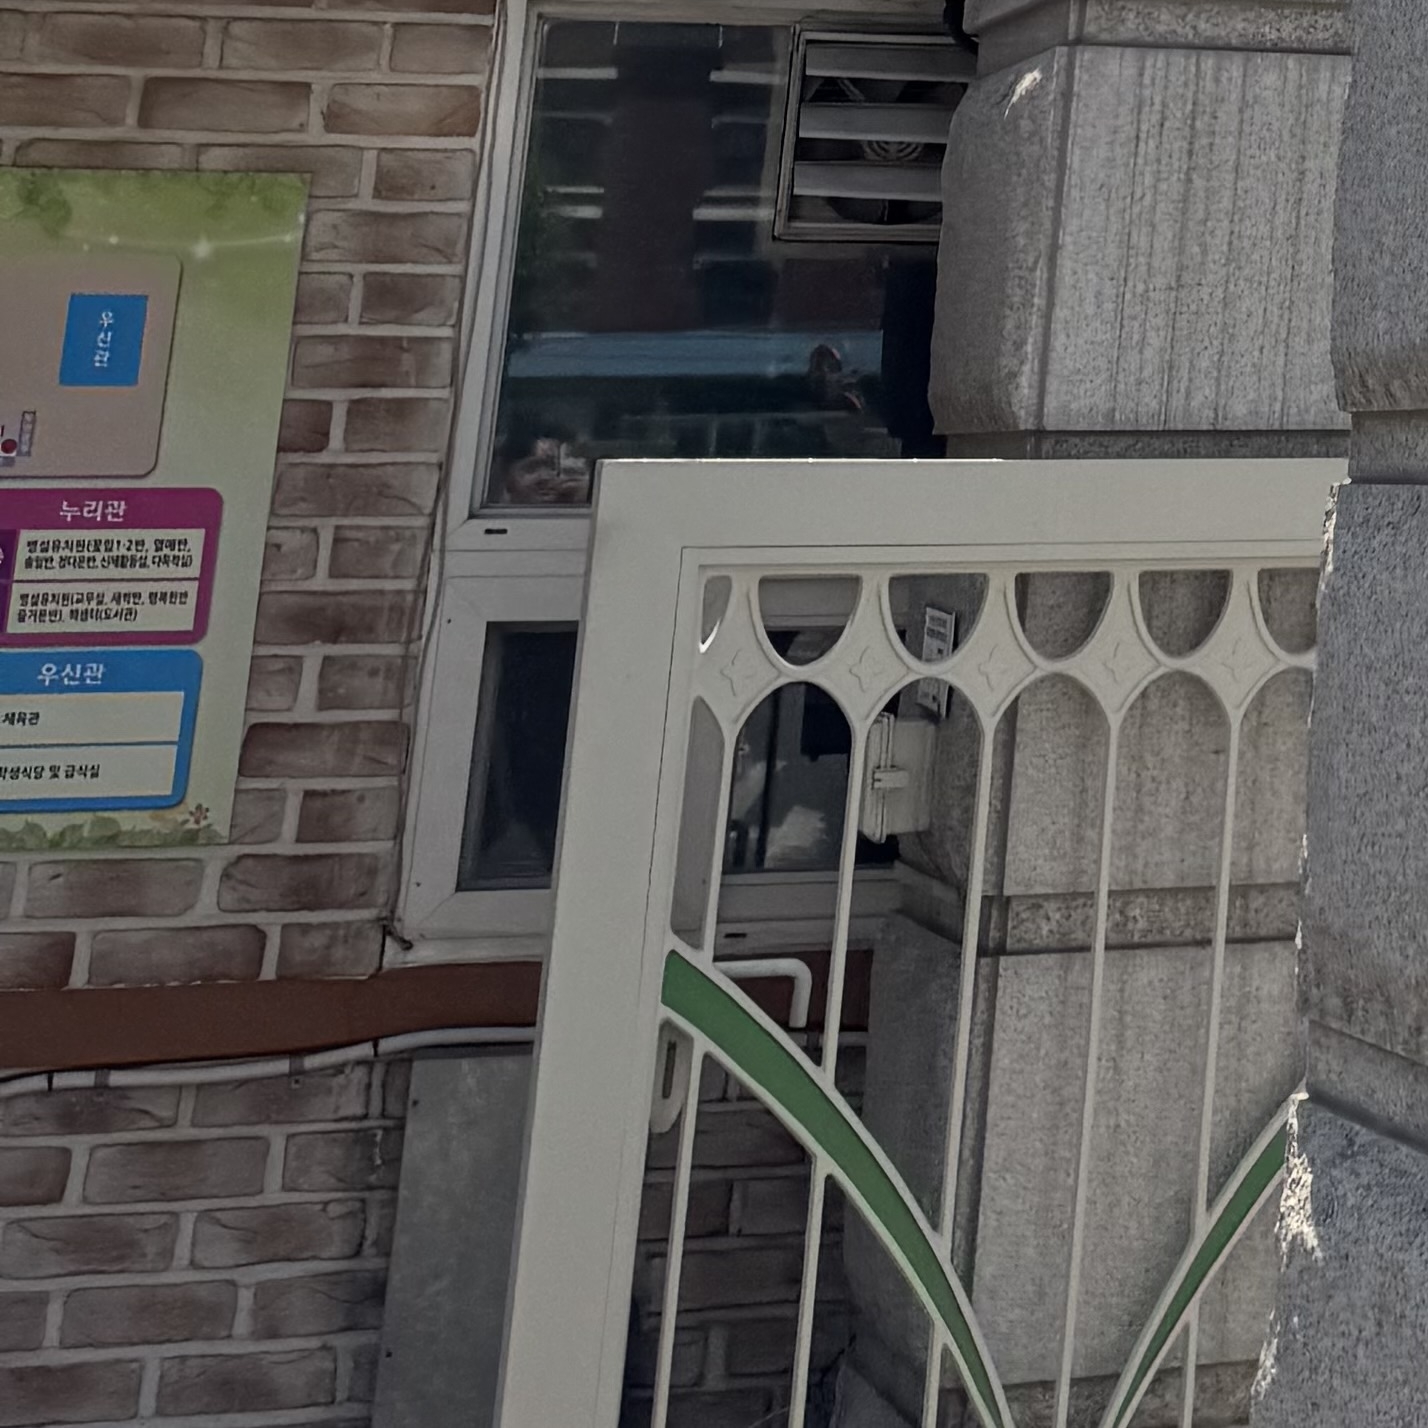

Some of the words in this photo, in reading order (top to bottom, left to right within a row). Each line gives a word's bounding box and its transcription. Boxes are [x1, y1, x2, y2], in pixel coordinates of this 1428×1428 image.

[93, 310, 114, 368] 우신관
[59, 500, 128, 522] 누리관
[37, 662, 106, 686] 우신관
[49, 764, 61, 779] 및
[64, 763, 101, 779] 급식실
